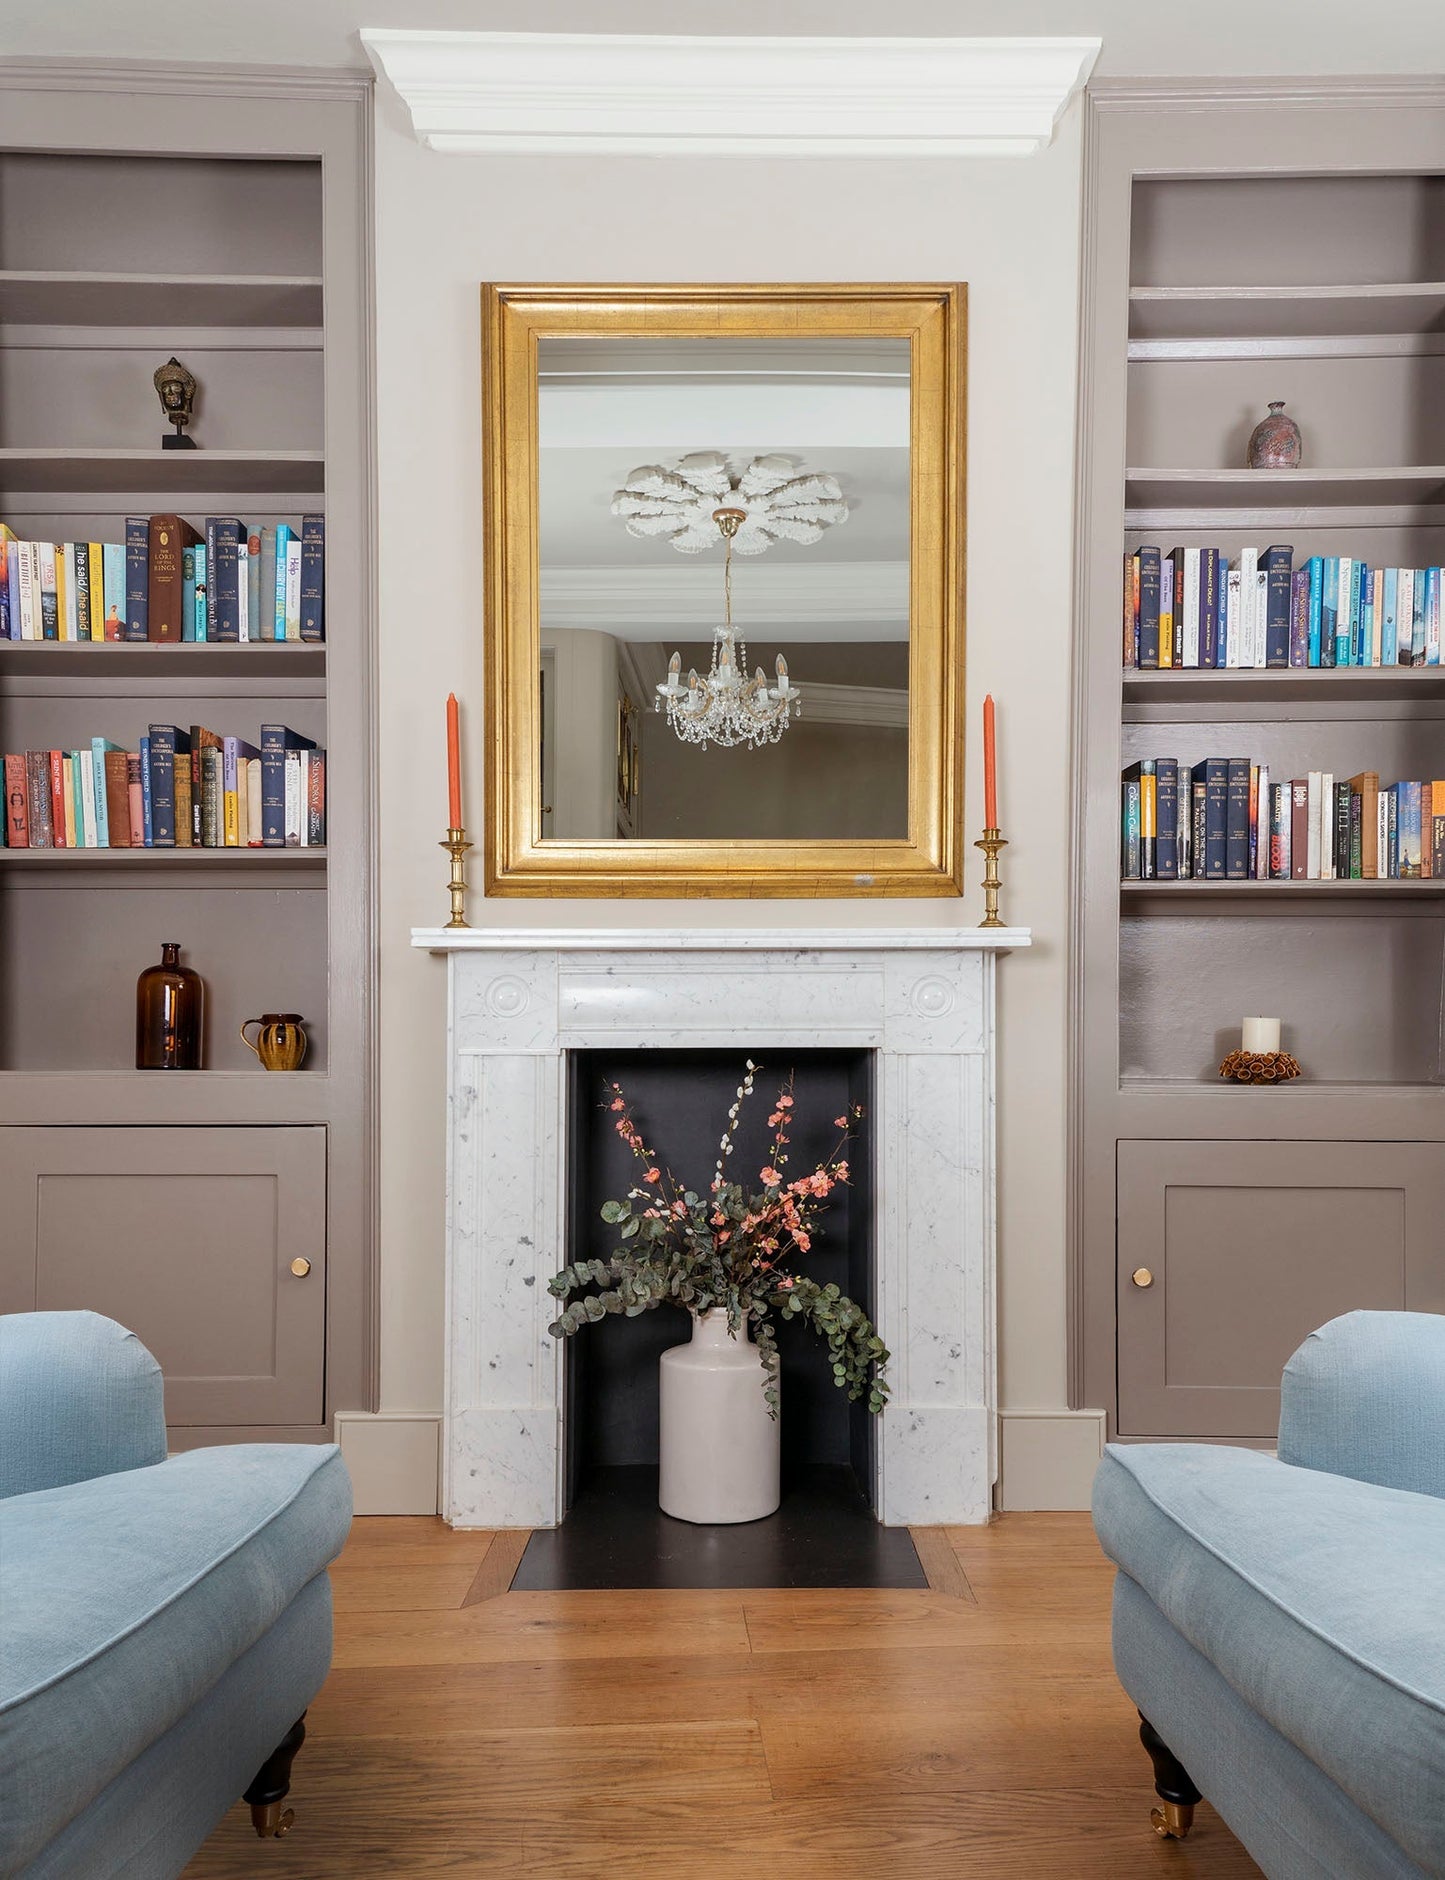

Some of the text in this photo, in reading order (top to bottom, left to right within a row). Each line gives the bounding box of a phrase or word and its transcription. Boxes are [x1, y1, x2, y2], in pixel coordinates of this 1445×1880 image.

[77, 552, 86, 564] he
[288, 557, 299, 576] Help
[46, 563, 54, 585] YRSA
[276, 564, 285, 585] CURRY
[1341, 567, 1349, 594] Special
[276, 587, 285, 600] GUY
[79, 611, 88, 630] said
[312, 761, 321, 805] SILKWORM
[1339, 797, 1348, 832] HILL
[1200, 827, 1205, 835] ON
[1271, 835, 1281, 870] BLOOD
